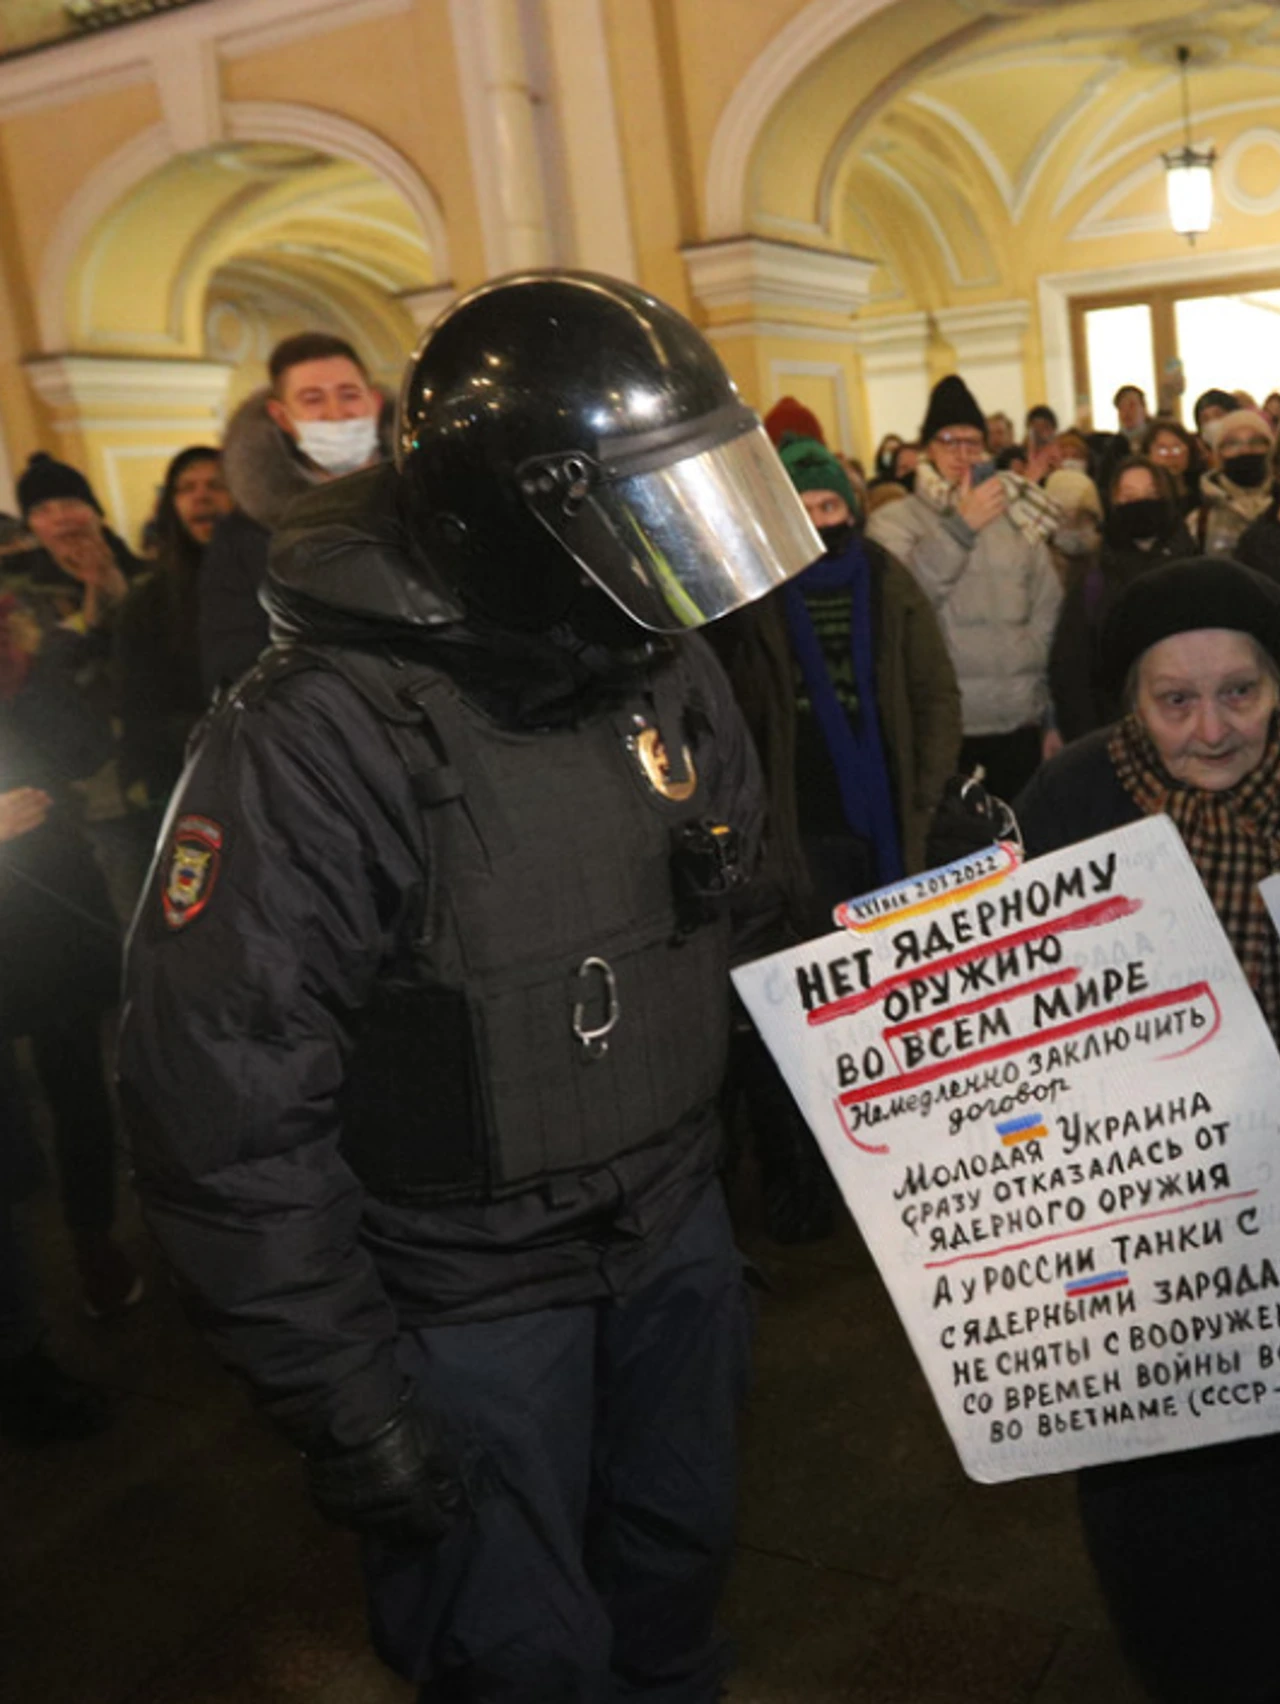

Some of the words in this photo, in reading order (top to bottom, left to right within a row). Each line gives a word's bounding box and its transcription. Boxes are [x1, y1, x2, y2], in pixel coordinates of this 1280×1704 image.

[795, 948, 873, 1011] НЕТ
[892, 852, 1117, 969] ЯДЕРНОМУ
[883, 935, 1062, 1022] ОРУЖИЮ
[837, 1046, 884, 1088] ВО
[902, 1008, 1011, 1069] ВСЕМ
[1033, 961, 1149, 1028] МИРЕ
[1027, 1007, 1206, 1077] ЗАКЛЮЧИТЬ
[901, 1187, 981, 1236] СРАЗУ
[993, 1138, 1184, 1203] ОТКАЗАЛАСЬ
[1195, 1121, 1231, 1150] ОТ
[929, 1196, 1086, 1252] ЯДЕРНОГО
[1098, 1162, 1231, 1214] ОРУЖИЯ
[932, 1274, 953, 1309] А
[983, 1247, 1096, 1295] РОССИИ
[1111, 1219, 1224, 1265] ТАНКИ
[1237, 1206, 1261, 1236] С
[939, 1324, 957, 1350] С
[962, 1288, 1137, 1346] ЯДЕРНЫМИ
[952, 1358, 988, 1388] НЕ
[995, 1337, 1091, 1377] СНЯТЫ
[1103, 1330, 1121, 1356] С
[962, 1391, 994, 1416] СО
[1004, 1372, 1122, 1414] ВРЕМЕН
[1136, 1350, 1241, 1389] ВОЙНЫ
[989, 1418, 1023, 1443] ВО
[1037, 1394, 1179, 1439] ВЬЕТНАМЕ
